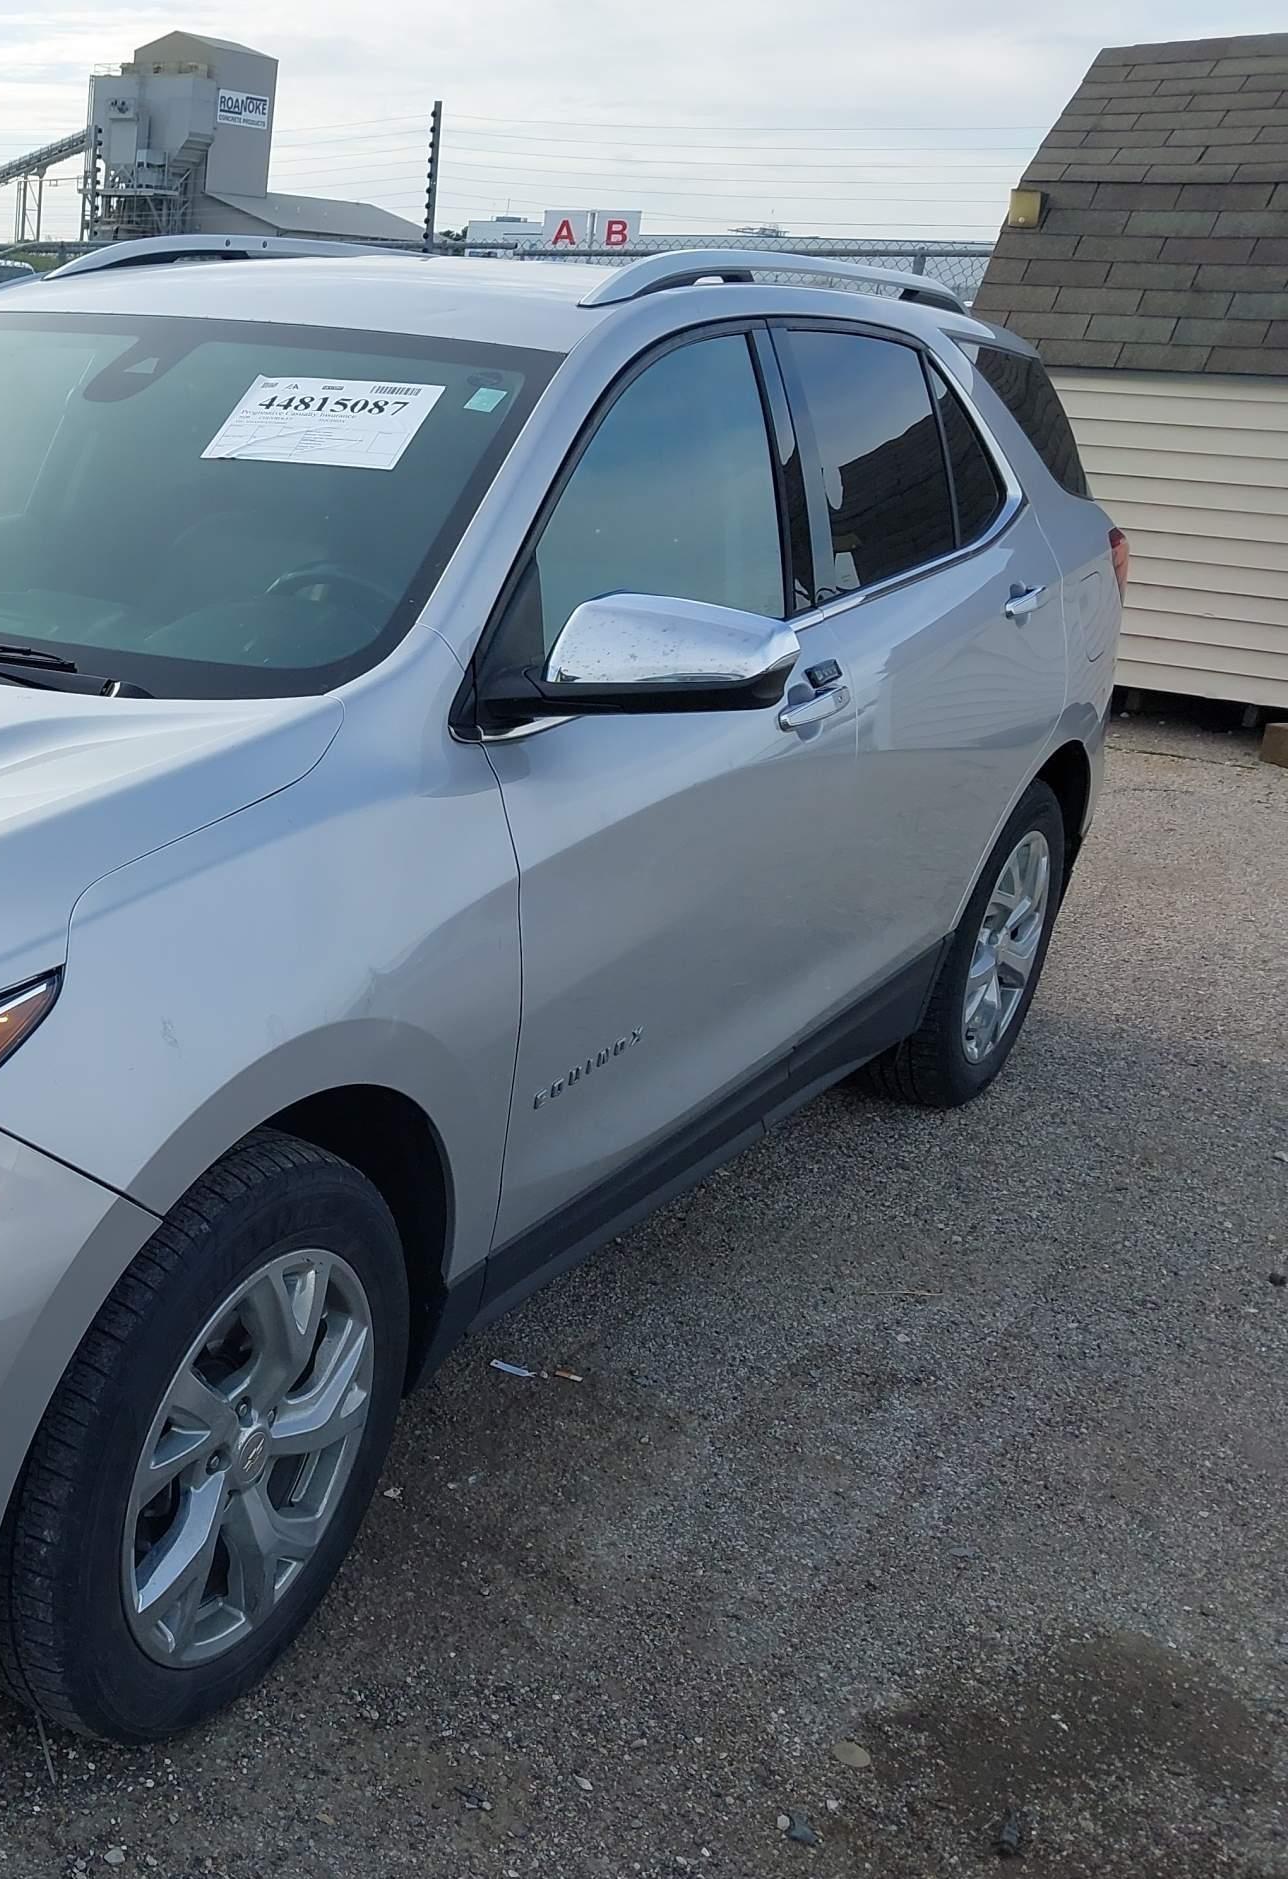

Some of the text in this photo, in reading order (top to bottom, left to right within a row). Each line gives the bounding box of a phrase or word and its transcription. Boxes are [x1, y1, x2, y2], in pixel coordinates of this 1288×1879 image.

[220, 95, 267, 116] ROANOKE
[552, 219, 576, 245] A
[605, 220, 628, 246] B
[259, 395, 410, 417] 44815087
[533, 1025, 644, 1110] EQUINOX
